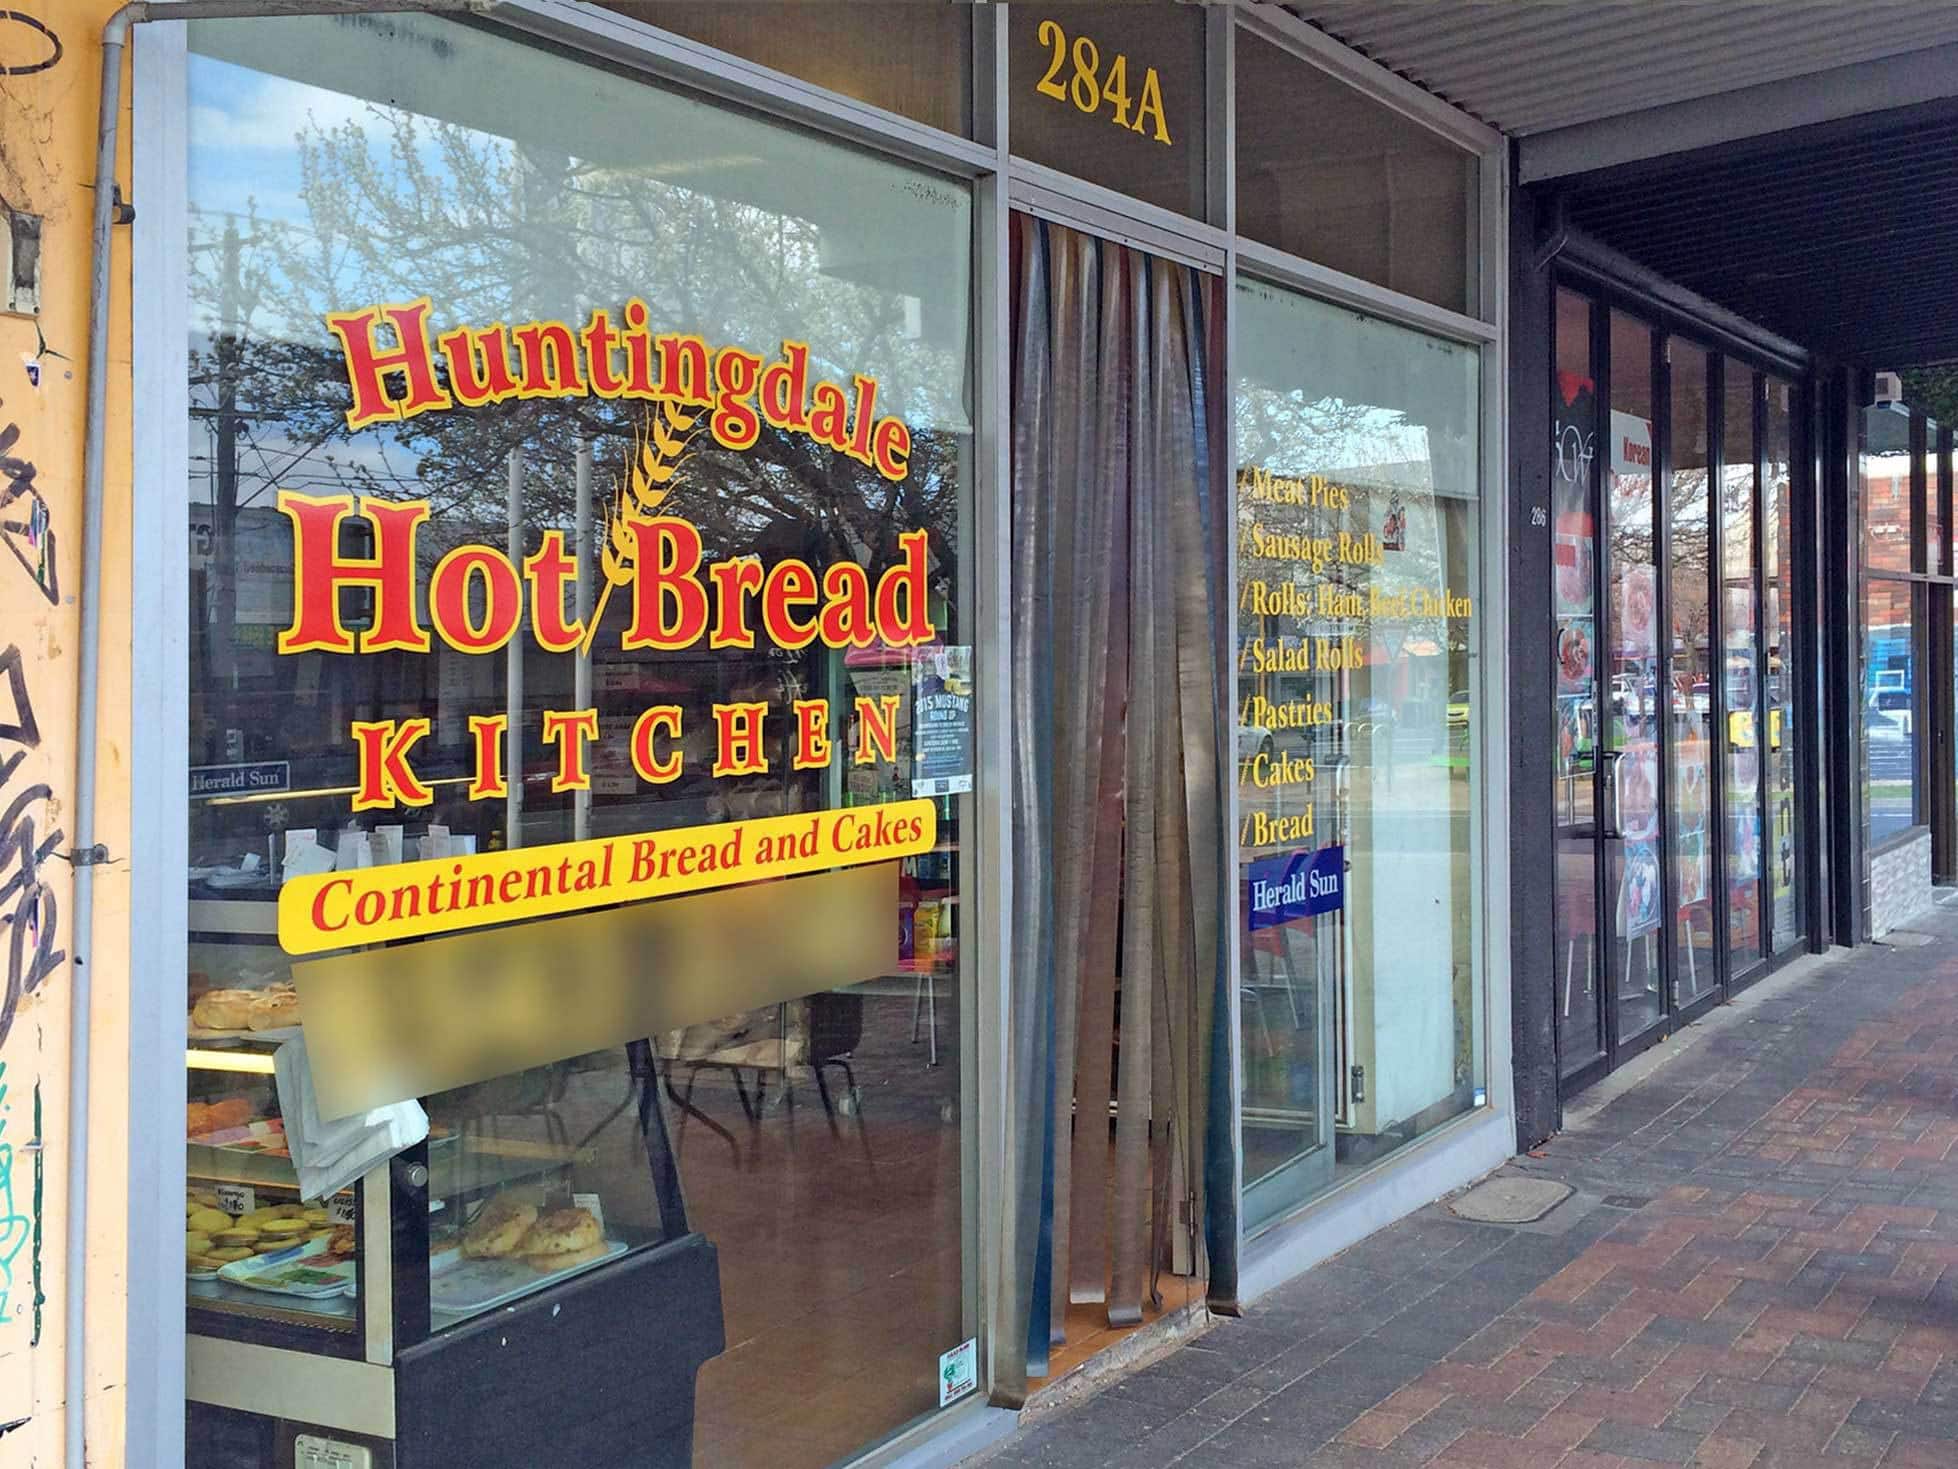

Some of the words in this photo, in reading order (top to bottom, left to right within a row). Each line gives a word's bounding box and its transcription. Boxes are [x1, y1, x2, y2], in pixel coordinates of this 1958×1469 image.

[1036, 20, 1173, 147] 284A
[326, 297, 913, 482] Huntingdale
[1251, 466, 1305, 505] Meat
[1311, 475, 1349, 511] Pies
[1252, 522, 1333, 574] Sausage
[1338, 531, 1385, 567] Rolls
[276, 490, 588, 655] Hot
[622, 516, 937, 652] Bread
[1252, 638, 1310, 673] Salad
[1315, 635, 1365, 671] Rolls
[1252, 694, 1333, 730] Pastries
[352, 694, 901, 813] KITCHEN
[1252, 752, 1315, 789] Cakes
[191, 771, 245, 791] Herald
[248, 770, 280, 785] Sun
[1253, 803, 1314, 847] Bread
[311, 842, 611, 932] Continental
[627, 827, 744, 884] Bread
[755, 819, 820, 863] and
[830, 810, 923, 853] Cakes
[1252, 872, 1306, 912] Herald
[1309, 869, 1338, 899] Sun
